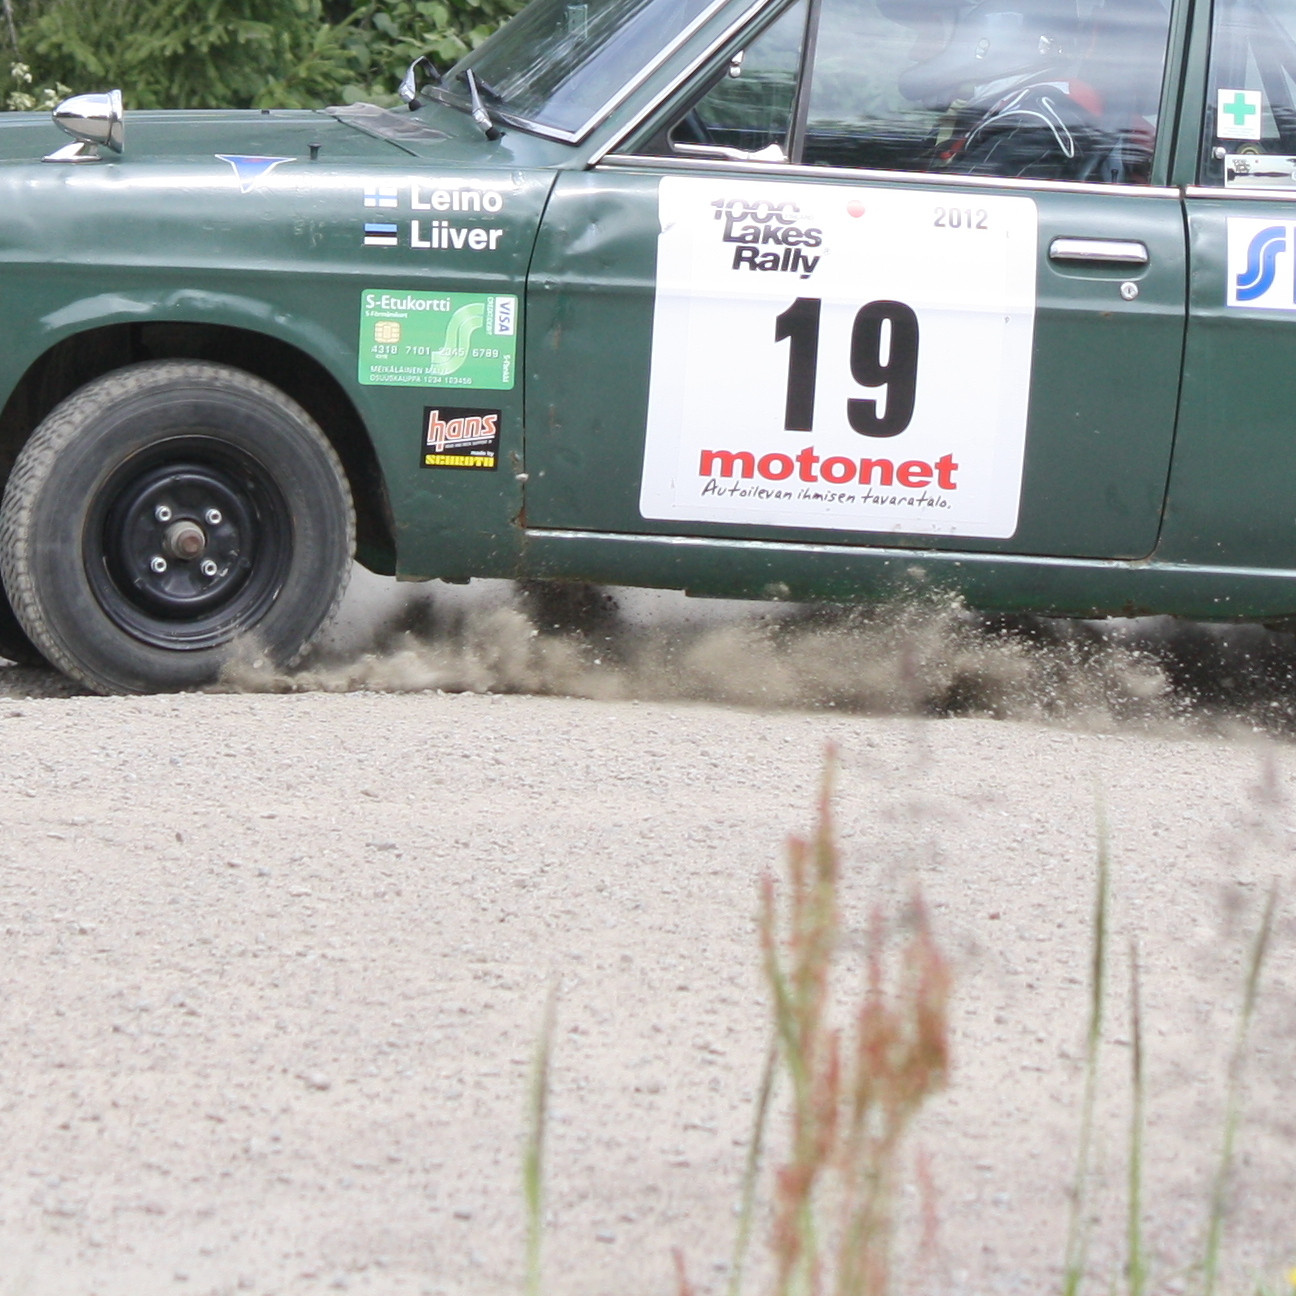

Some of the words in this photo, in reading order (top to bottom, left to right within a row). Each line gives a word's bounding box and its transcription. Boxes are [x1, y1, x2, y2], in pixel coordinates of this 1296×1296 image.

[411, 181, 503, 213] Leino
[722, 218, 823, 247] Lakes
[934, 206, 988, 229] 2012
[411, 220, 503, 250] Liiver
[732, 245, 821, 279] Rally
[365, 294, 450, 312] S-Etukortti
[499, 302, 510, 333] VISA
[775, 296, 919, 438] 19
[427, 410, 498, 452] hans
[699, 445, 958, 490] motonet
[701, 478, 792, 500] Autoilevan
[797, 487, 855, 504] ihmisen
